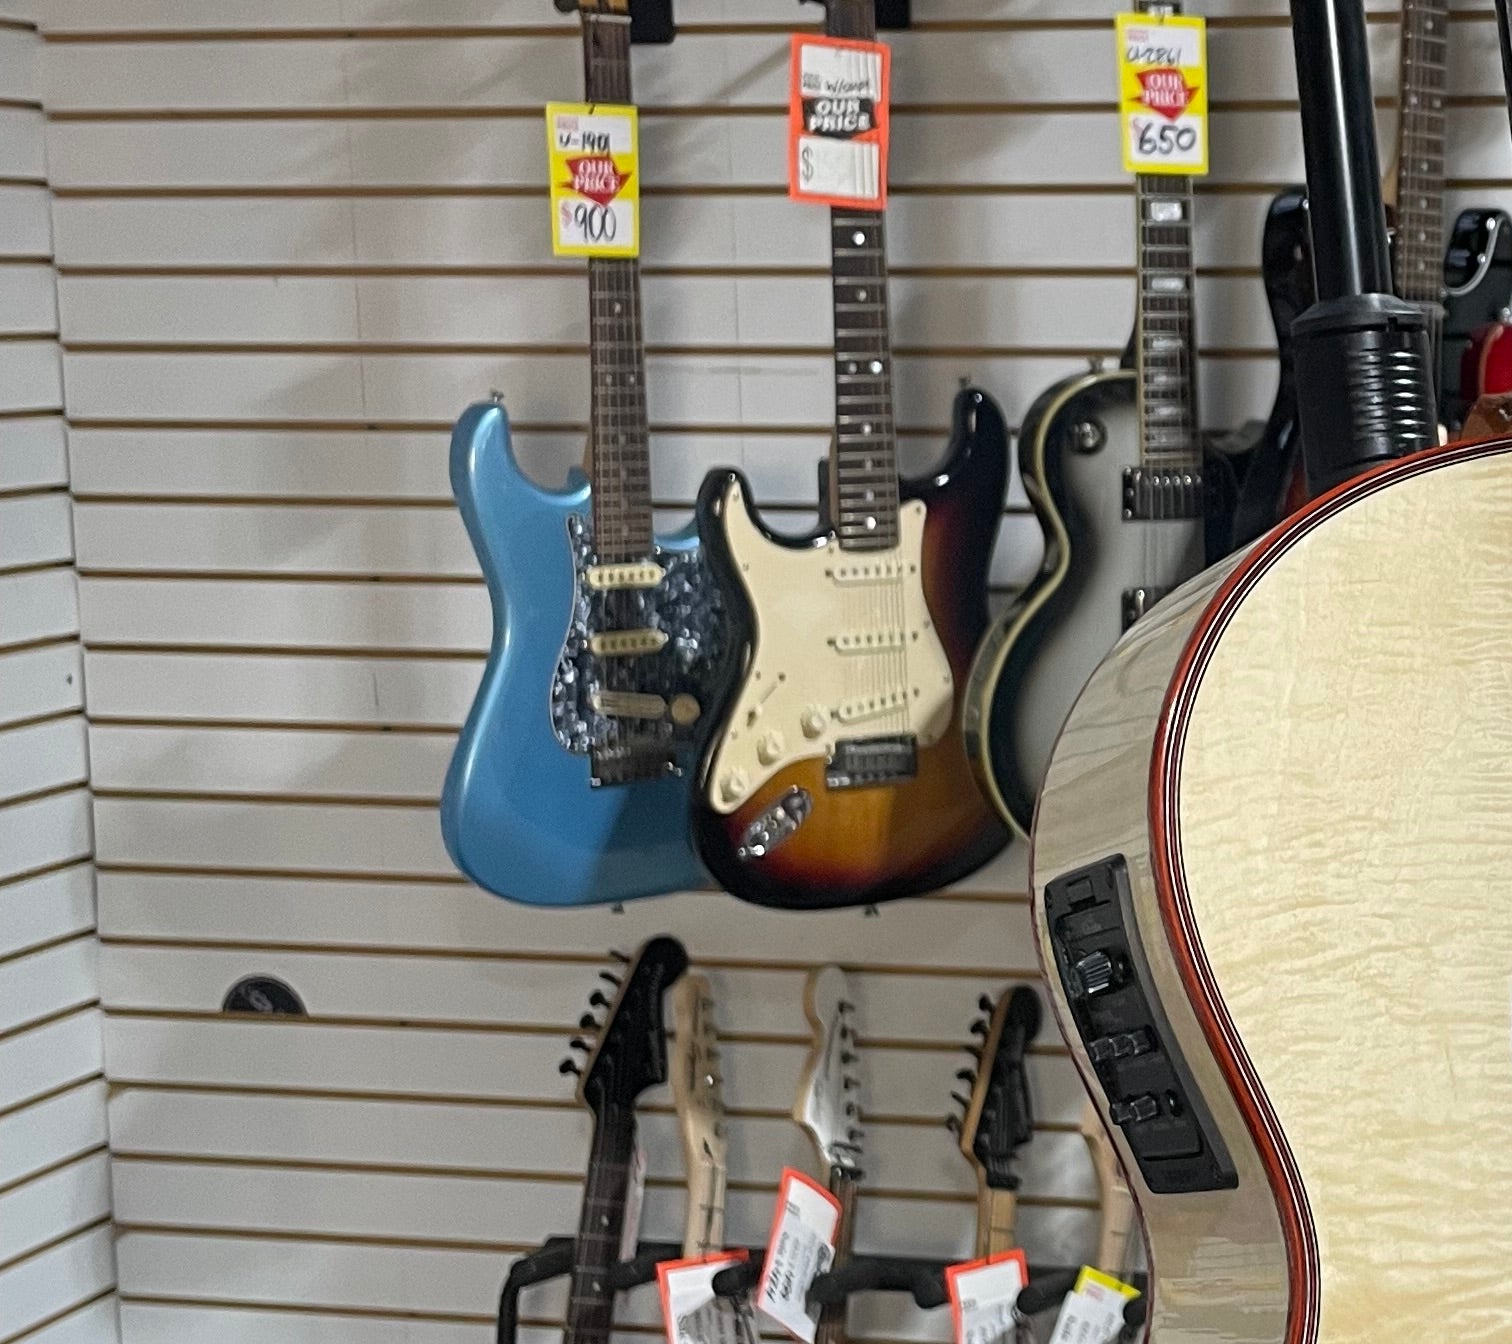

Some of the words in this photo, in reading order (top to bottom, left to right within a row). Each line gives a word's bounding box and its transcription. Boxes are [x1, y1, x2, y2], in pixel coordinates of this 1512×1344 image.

[1149, 73, 1183, 90] OUR
[816, 99, 861, 115] OUR
[1143, 88, 1187, 107] PRICE
[809, 113, 871, 133] PRICE
[577, 158, 614, 177] OUR
[573, 174, 621, 194] PRICE
